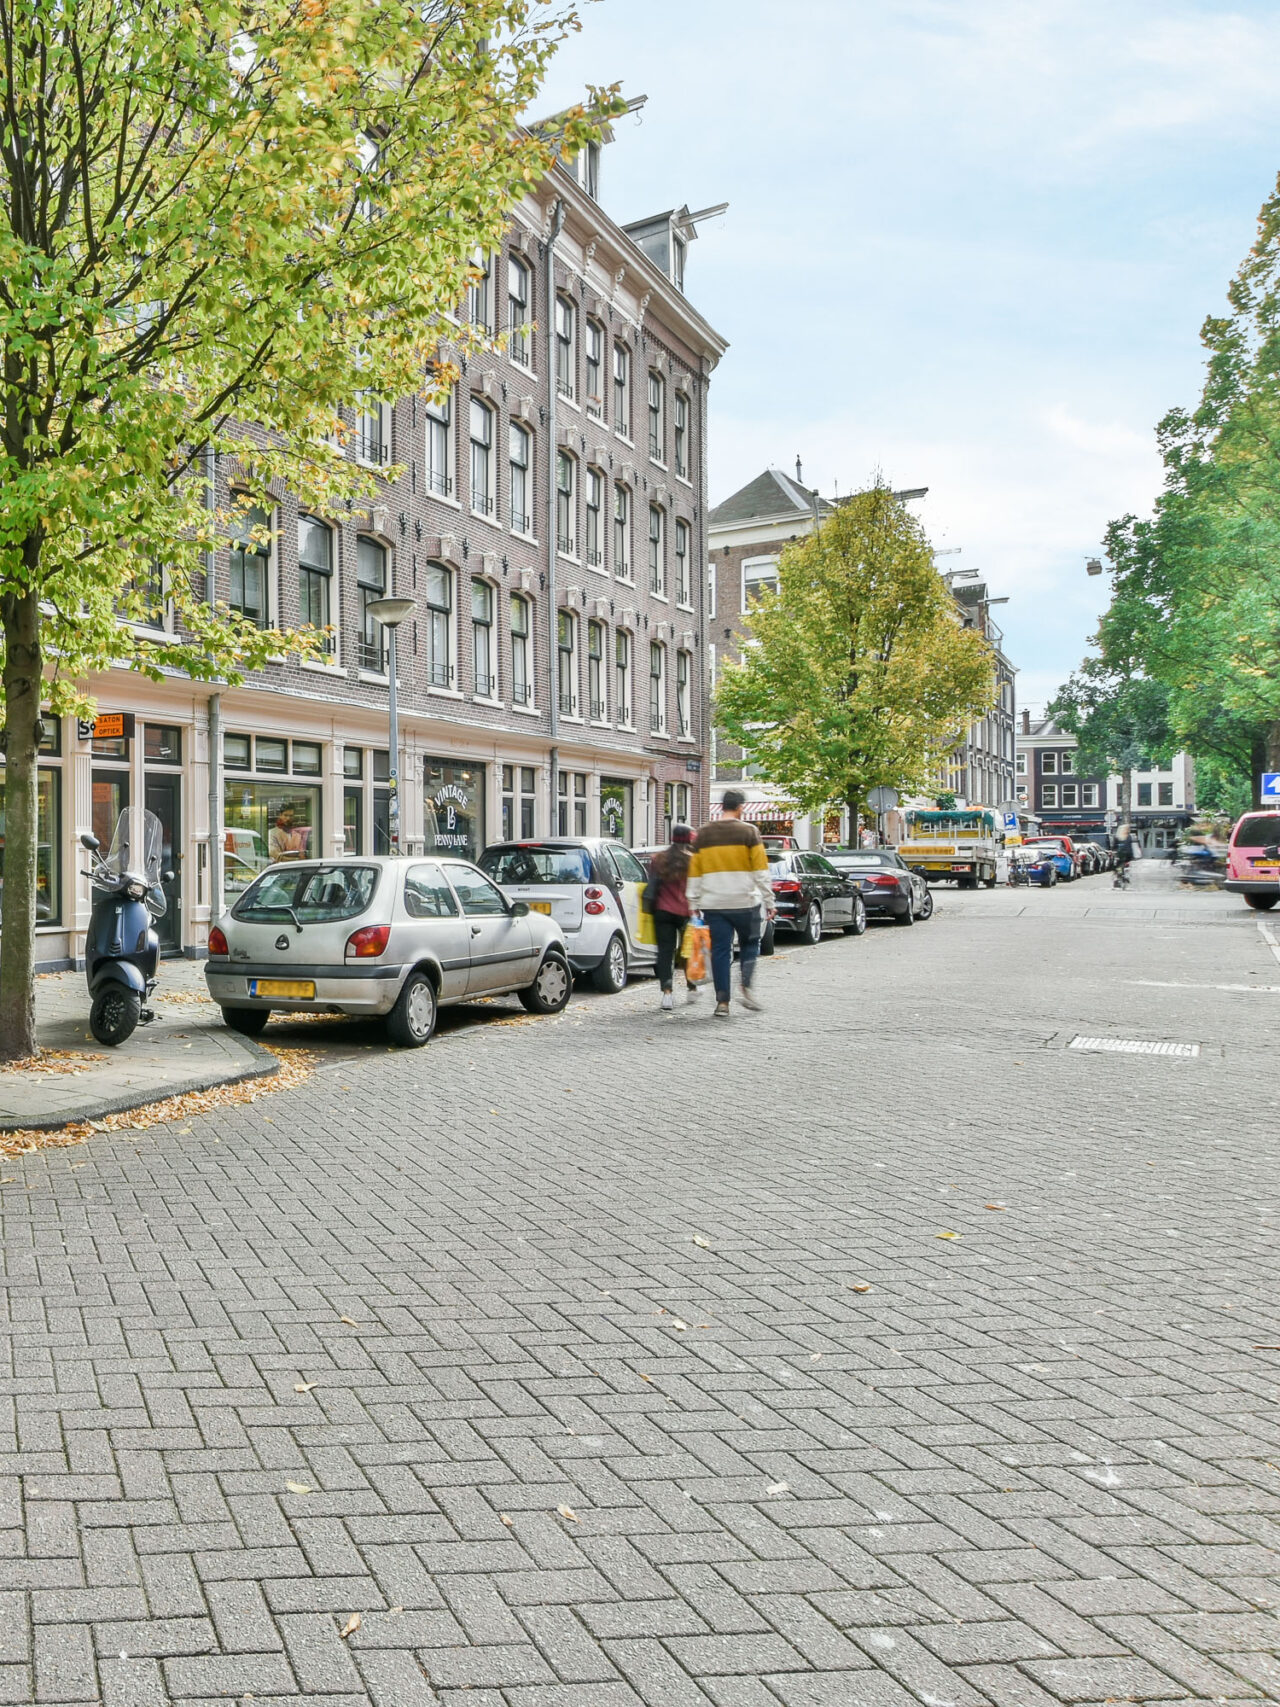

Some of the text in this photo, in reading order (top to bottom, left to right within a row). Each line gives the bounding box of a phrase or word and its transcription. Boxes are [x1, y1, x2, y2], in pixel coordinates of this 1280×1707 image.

[99, 728, 121, 736] OPTIEK
[434, 784, 468, 810] VINTAGE
[1006, 813, 1014, 824] P
[453, 834, 468, 846] LANE
